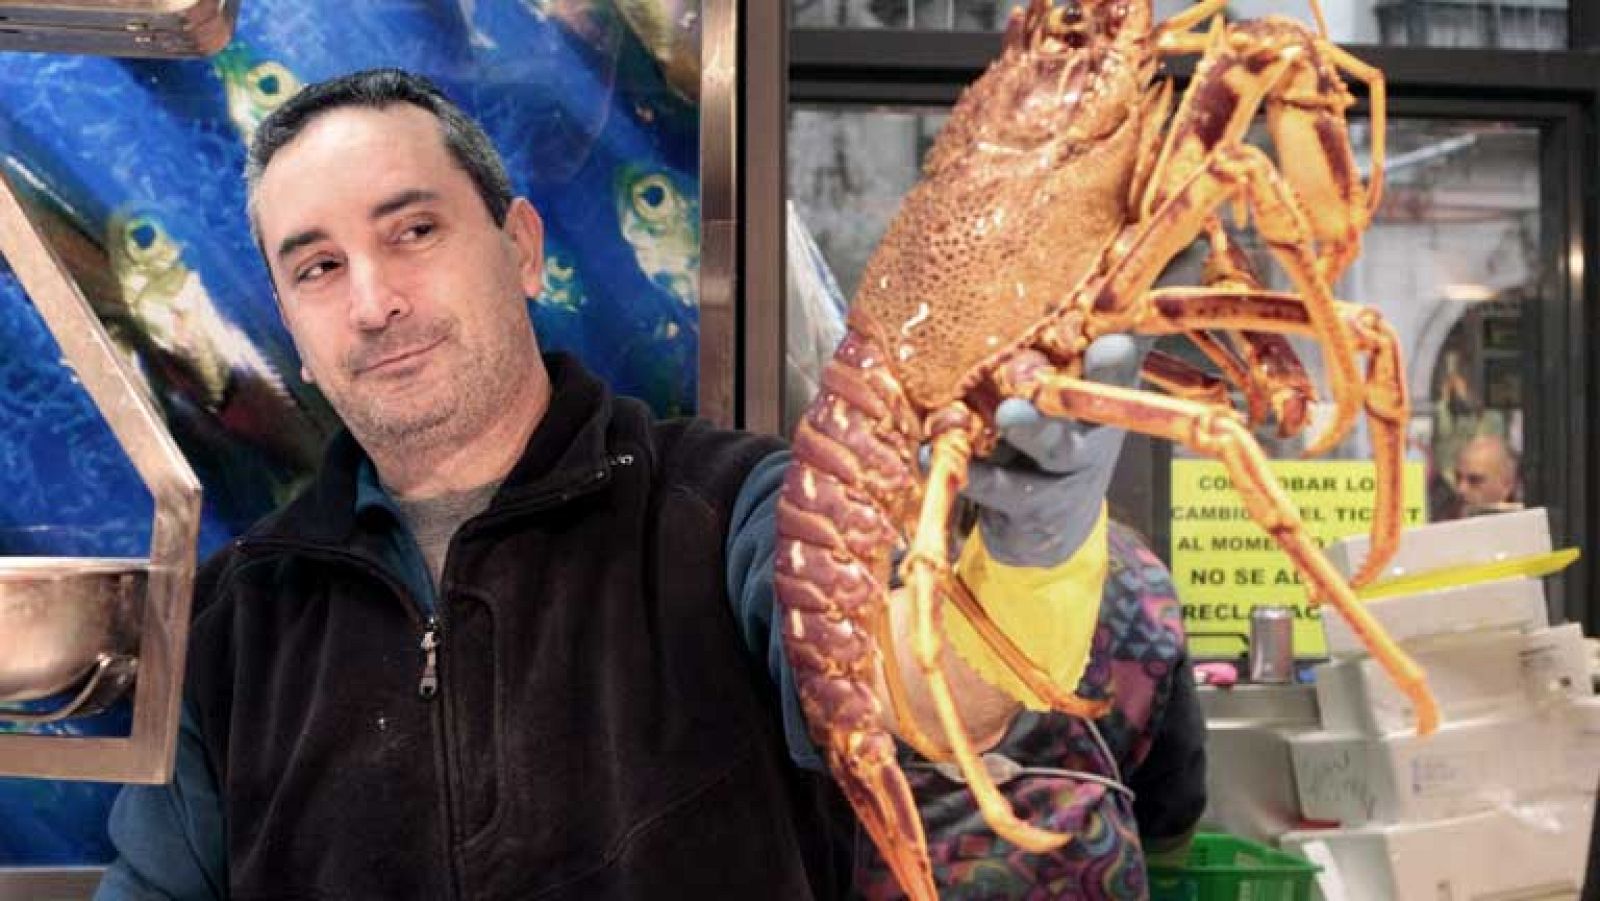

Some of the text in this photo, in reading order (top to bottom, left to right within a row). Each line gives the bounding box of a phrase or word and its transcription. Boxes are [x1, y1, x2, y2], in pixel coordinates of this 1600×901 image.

[1177, 536, 1204, 551] AL
[1190, 568, 1225, 585] NO
[1234, 568, 1266, 585] SE
